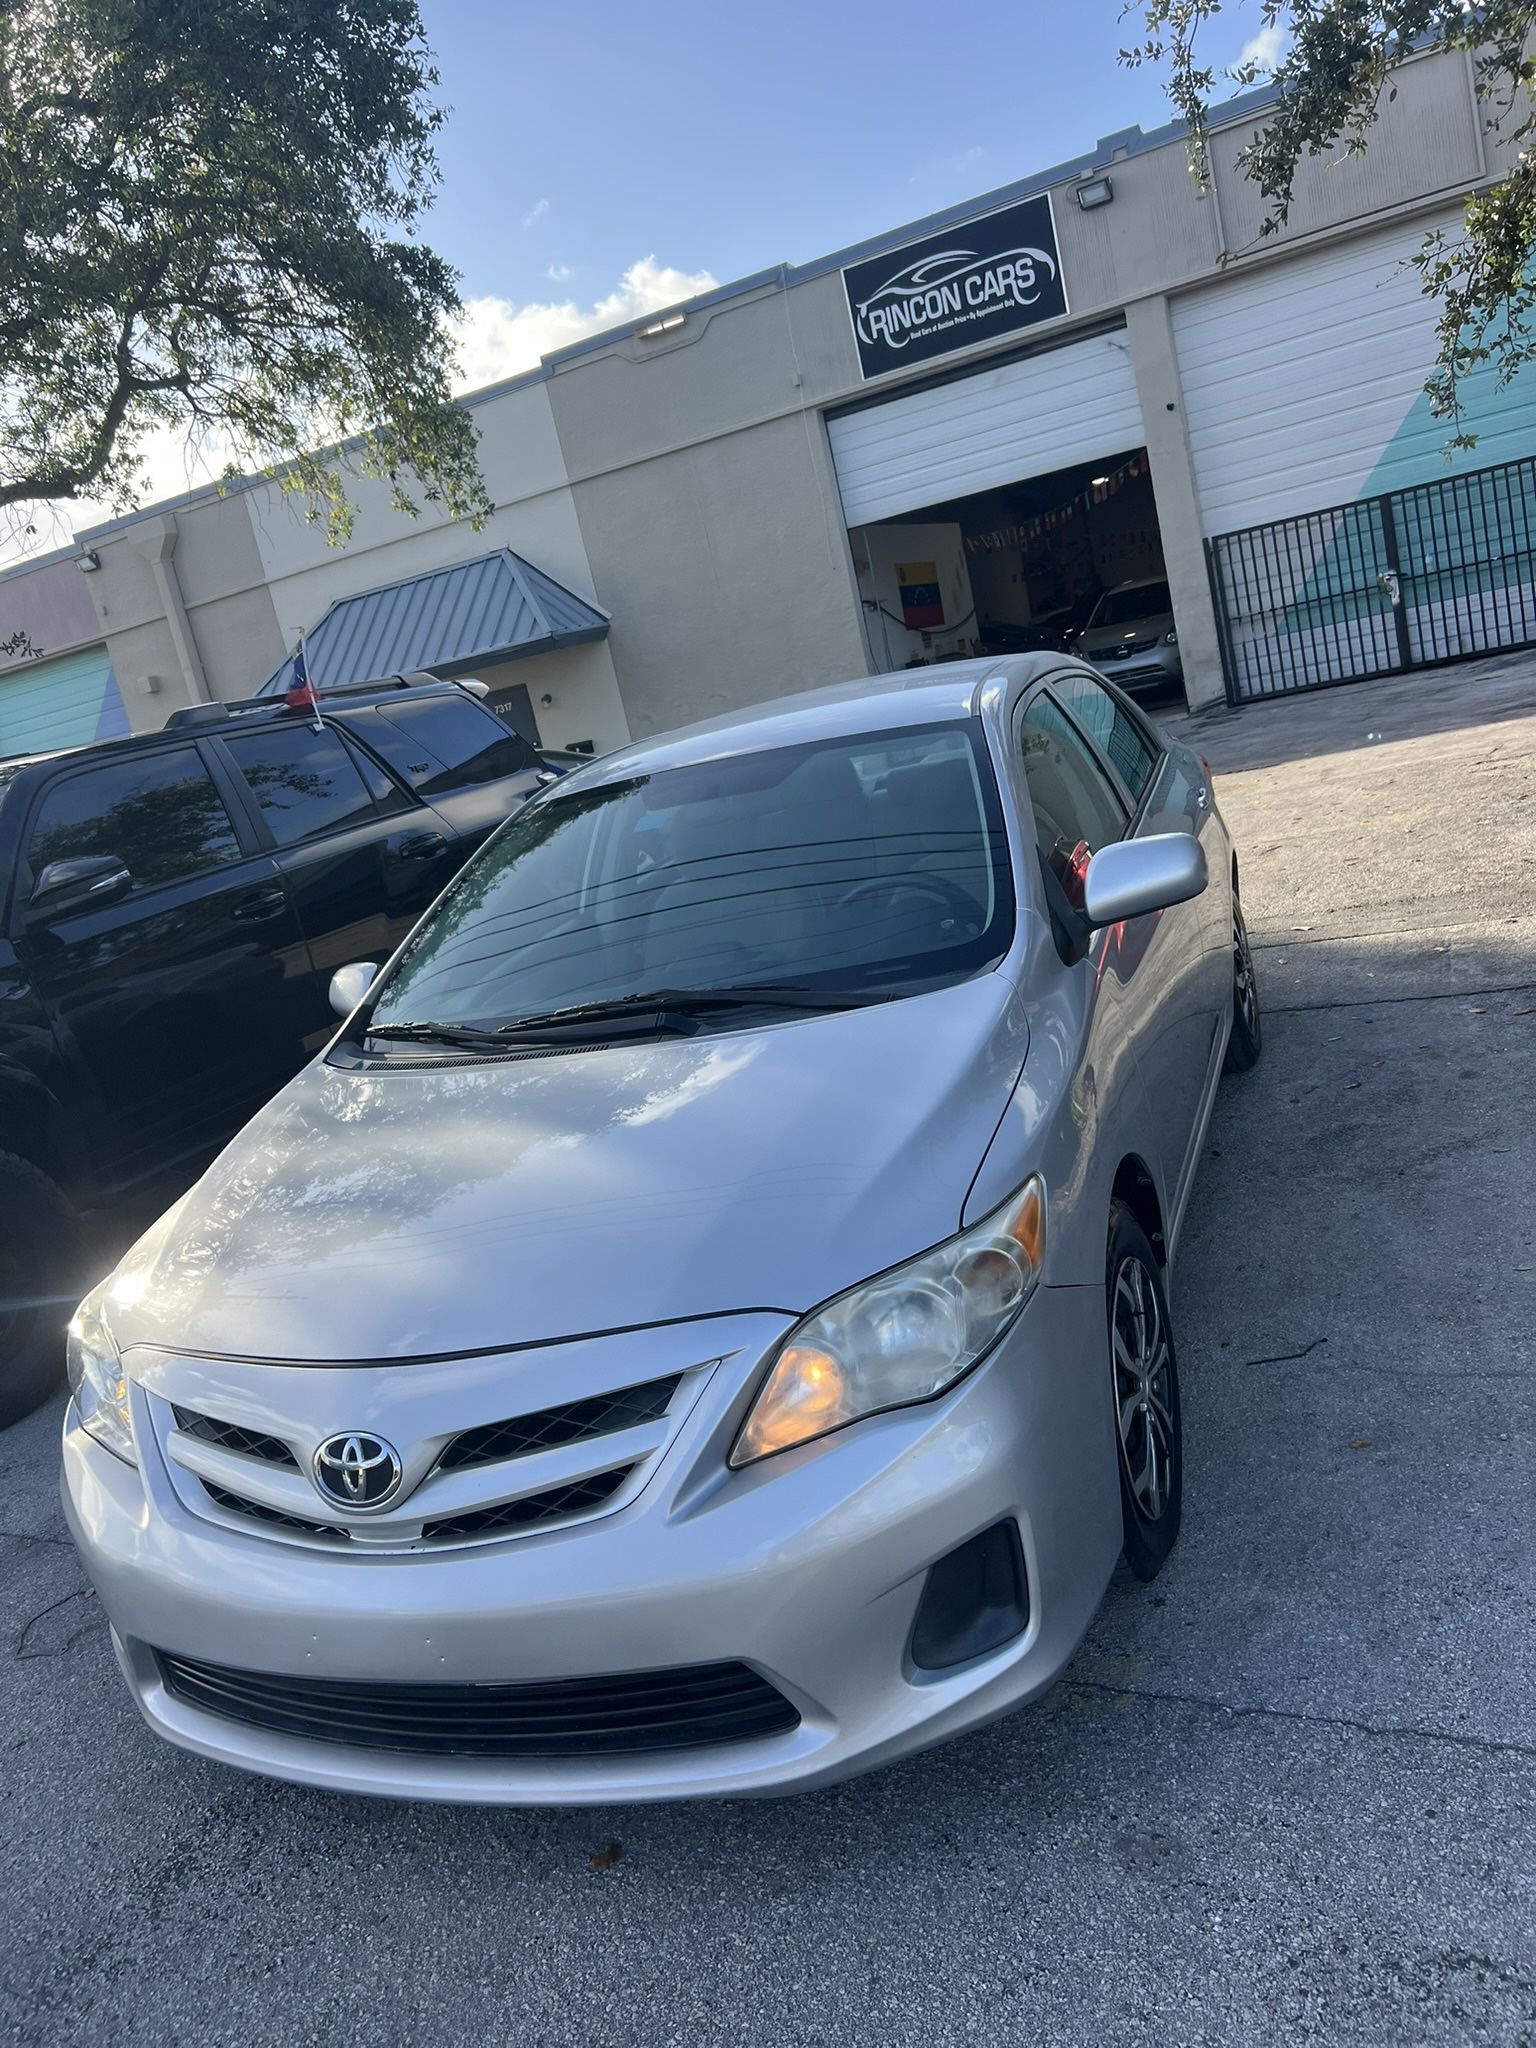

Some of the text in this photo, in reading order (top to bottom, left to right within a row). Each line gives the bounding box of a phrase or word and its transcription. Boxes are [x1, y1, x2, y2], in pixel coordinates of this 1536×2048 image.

[868, 258, 1039, 348] RINCON CARS
[921, 327, 932, 336] Cars
[494, 702, 513, 715] 7317
